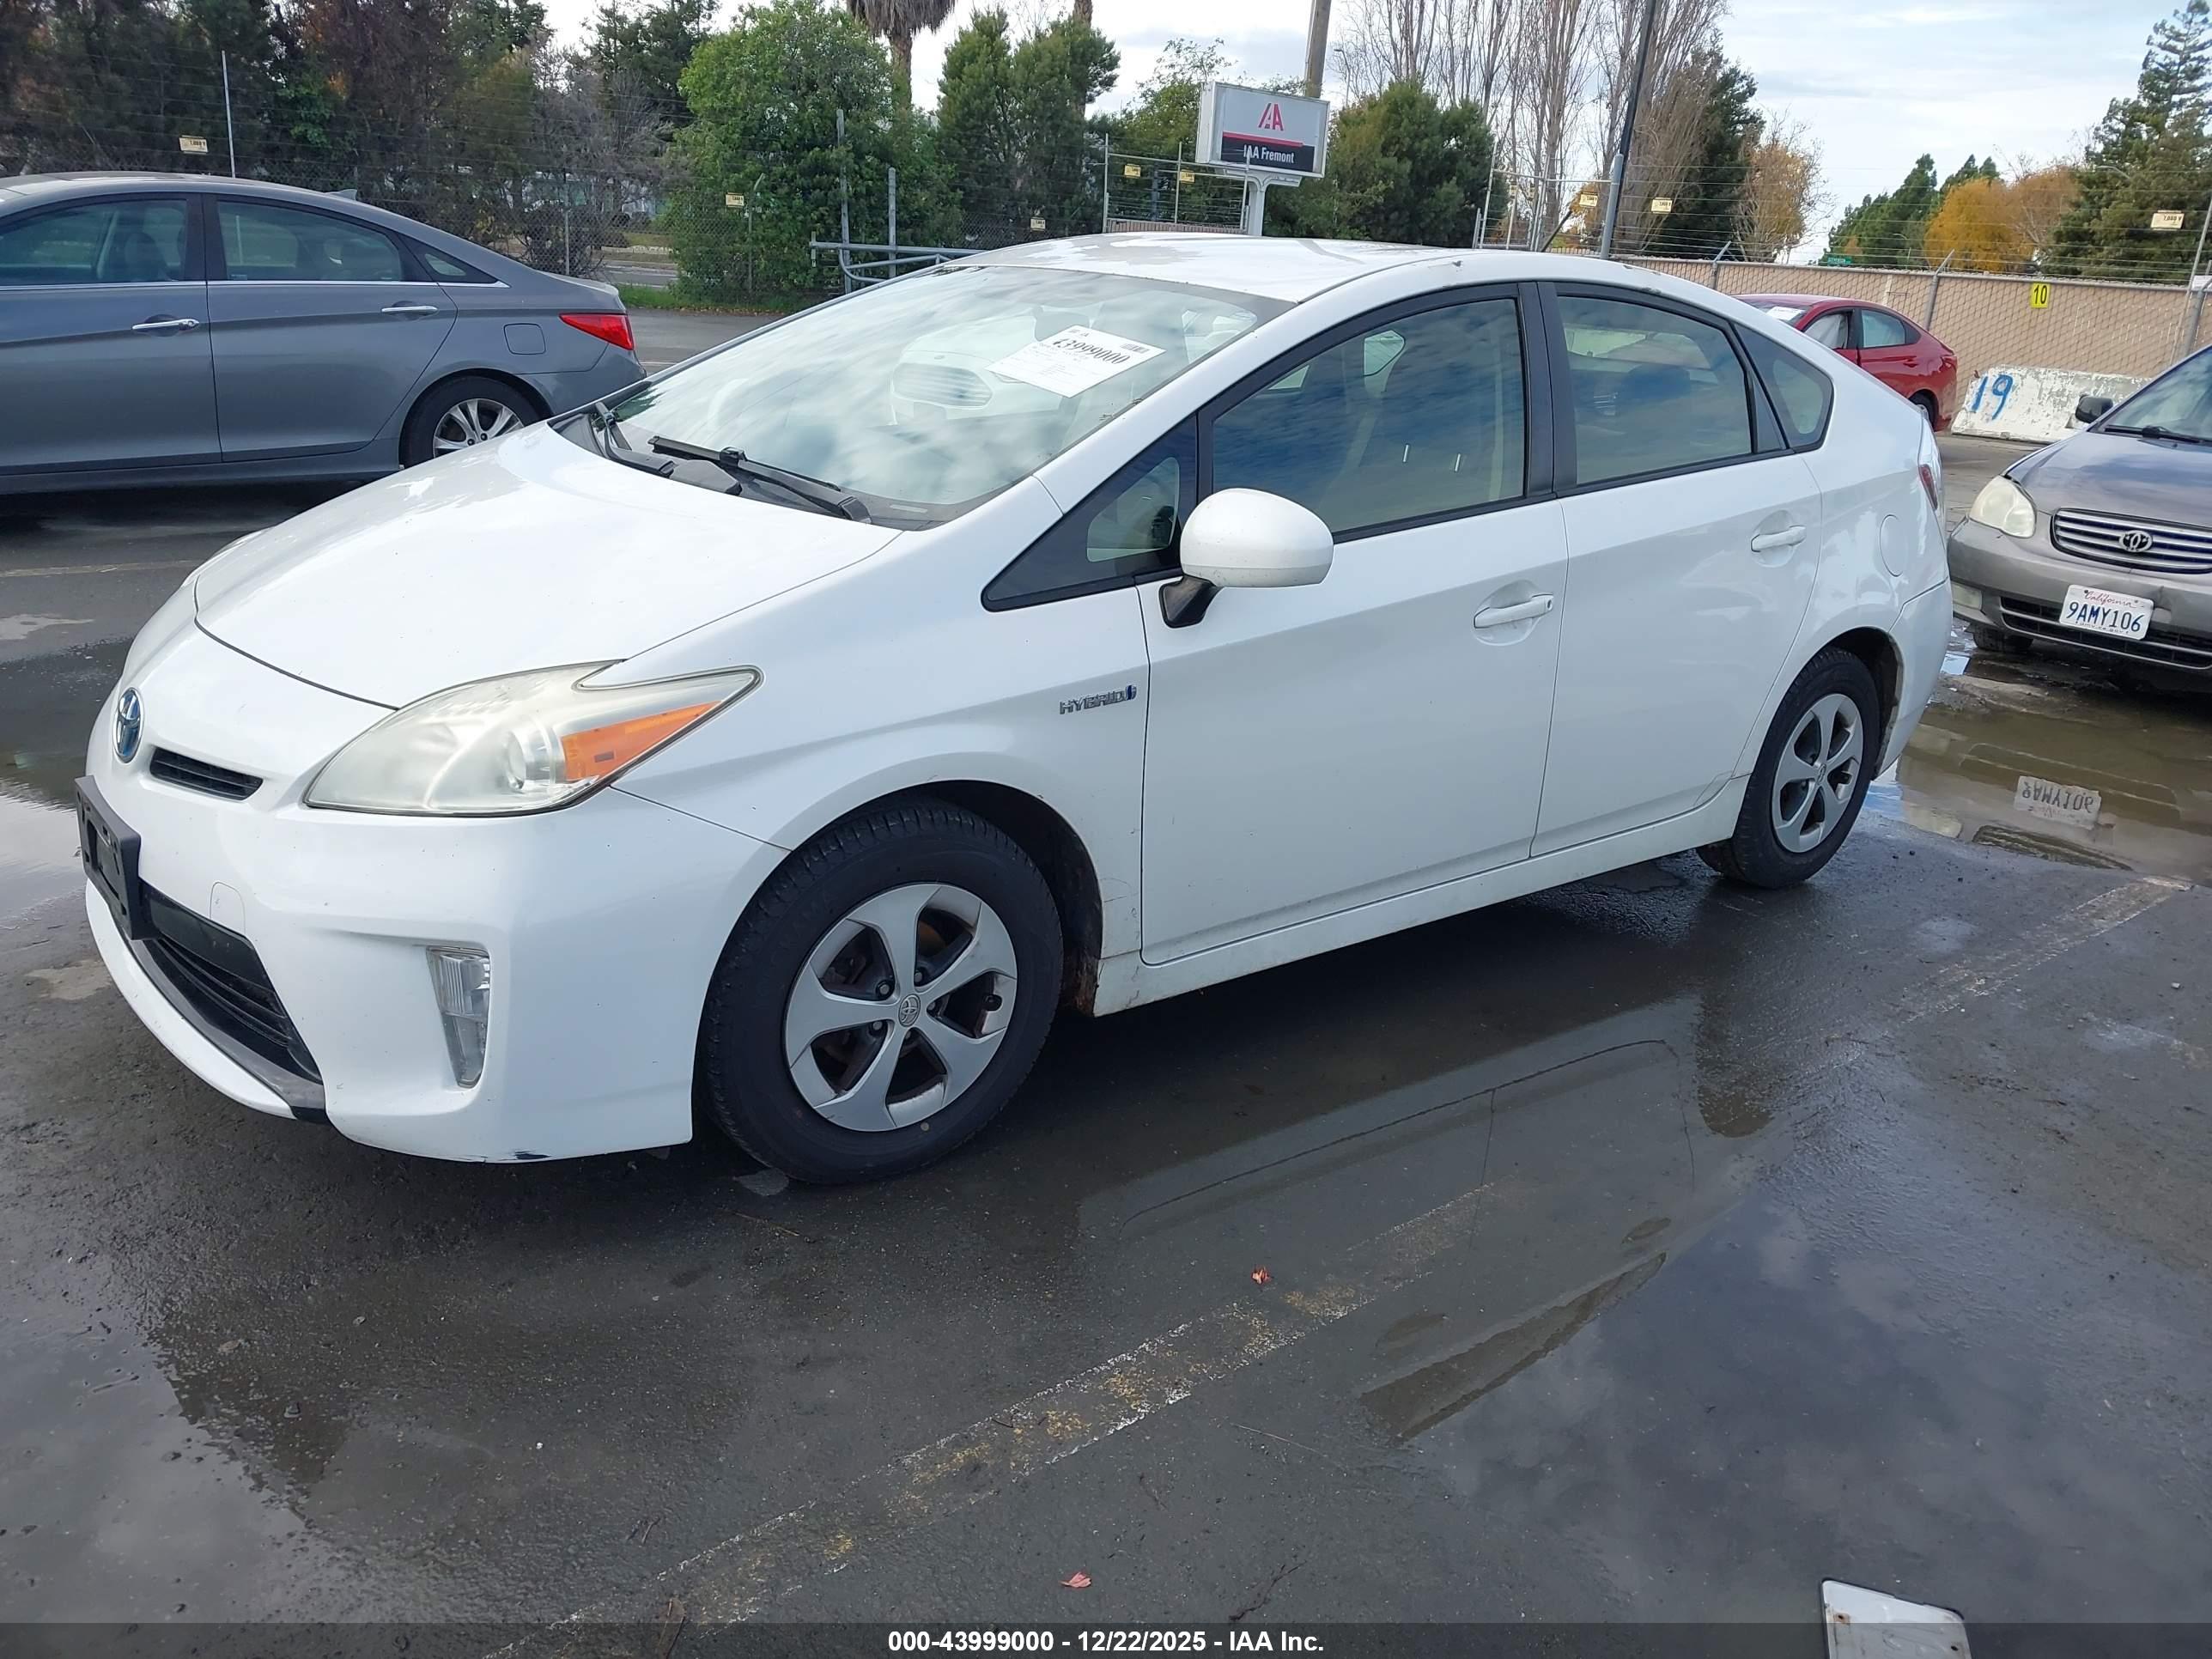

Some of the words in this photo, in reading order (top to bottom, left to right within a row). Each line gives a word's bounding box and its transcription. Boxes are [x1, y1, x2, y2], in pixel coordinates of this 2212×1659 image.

[1243, 144, 1260, 159] IAA
[1261, 147, 1295, 164] Fremont
[2033, 284, 2048, 305] 10
[1053, 337, 1130, 364] 43999000
[1972, 374, 2014, 420] 19
[2084, 591, 2137, 609] California
[2066, 601, 2145, 632] 9AMY106
[1060, 690, 1127, 715] HYBRID
